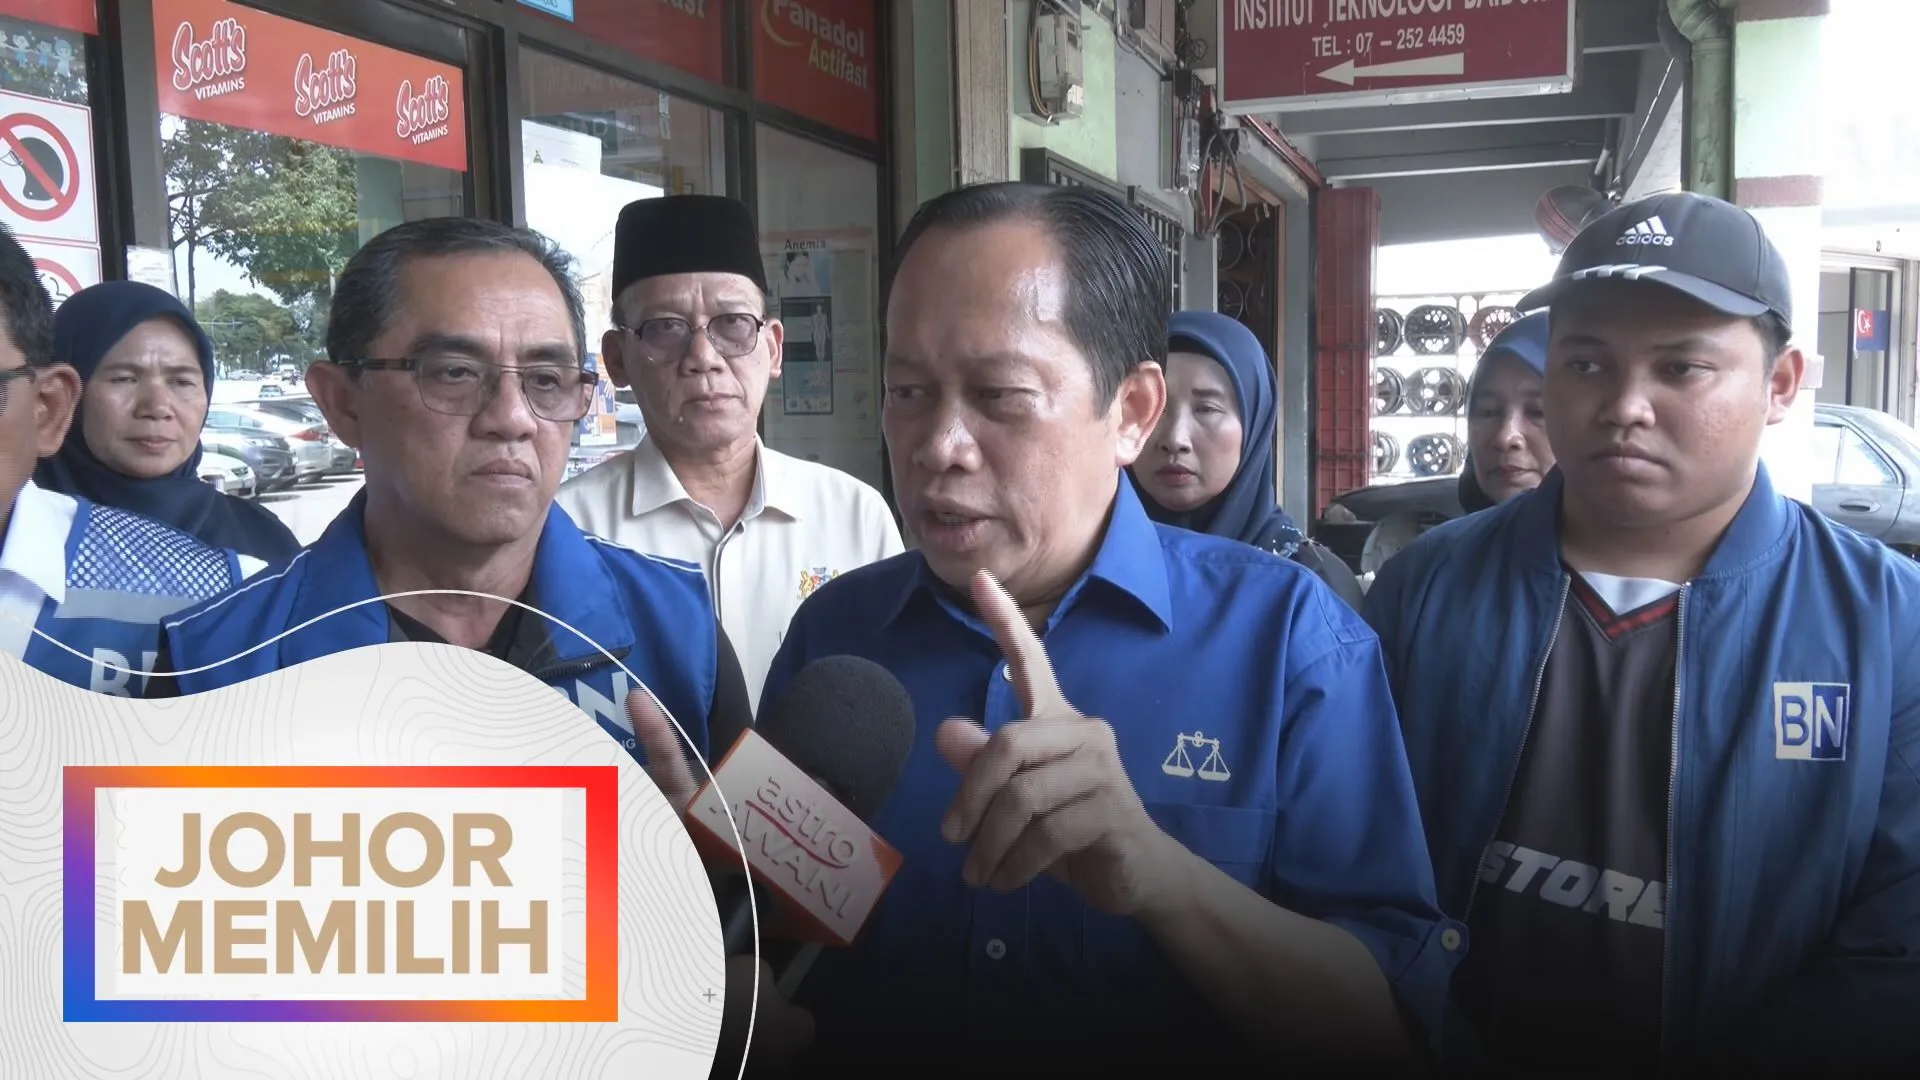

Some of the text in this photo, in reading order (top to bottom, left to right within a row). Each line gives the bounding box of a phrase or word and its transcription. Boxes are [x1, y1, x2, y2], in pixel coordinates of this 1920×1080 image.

[1234, 0, 1451, 31] INSTITUT TEKNO
[1312, 36, 1341, 57] TEL
[1355, 32, 1373, 54] 07
[1396, 28, 1424, 50] 252
[1428, 23, 1465, 47] 4459
[172, 17, 246, 91] Scott's
[808, 37, 868, 90] Actifast
[194, 76, 246, 100] VITAMINS
[294, 48, 356, 117] Scott's
[396, 74, 449, 138] Scott's
[312, 102, 356, 125] VITAMINS
[411, 125, 449, 145] VITAMINS
[784, 239, 827, 251] Anemia
[1615, 232, 1675, 247] adidas
[551, 670, 636, 737] N
[1780, 694, 1844, 749] BN
[756, 776, 857, 866] astro
[708, 802, 856, 919] AWANI
